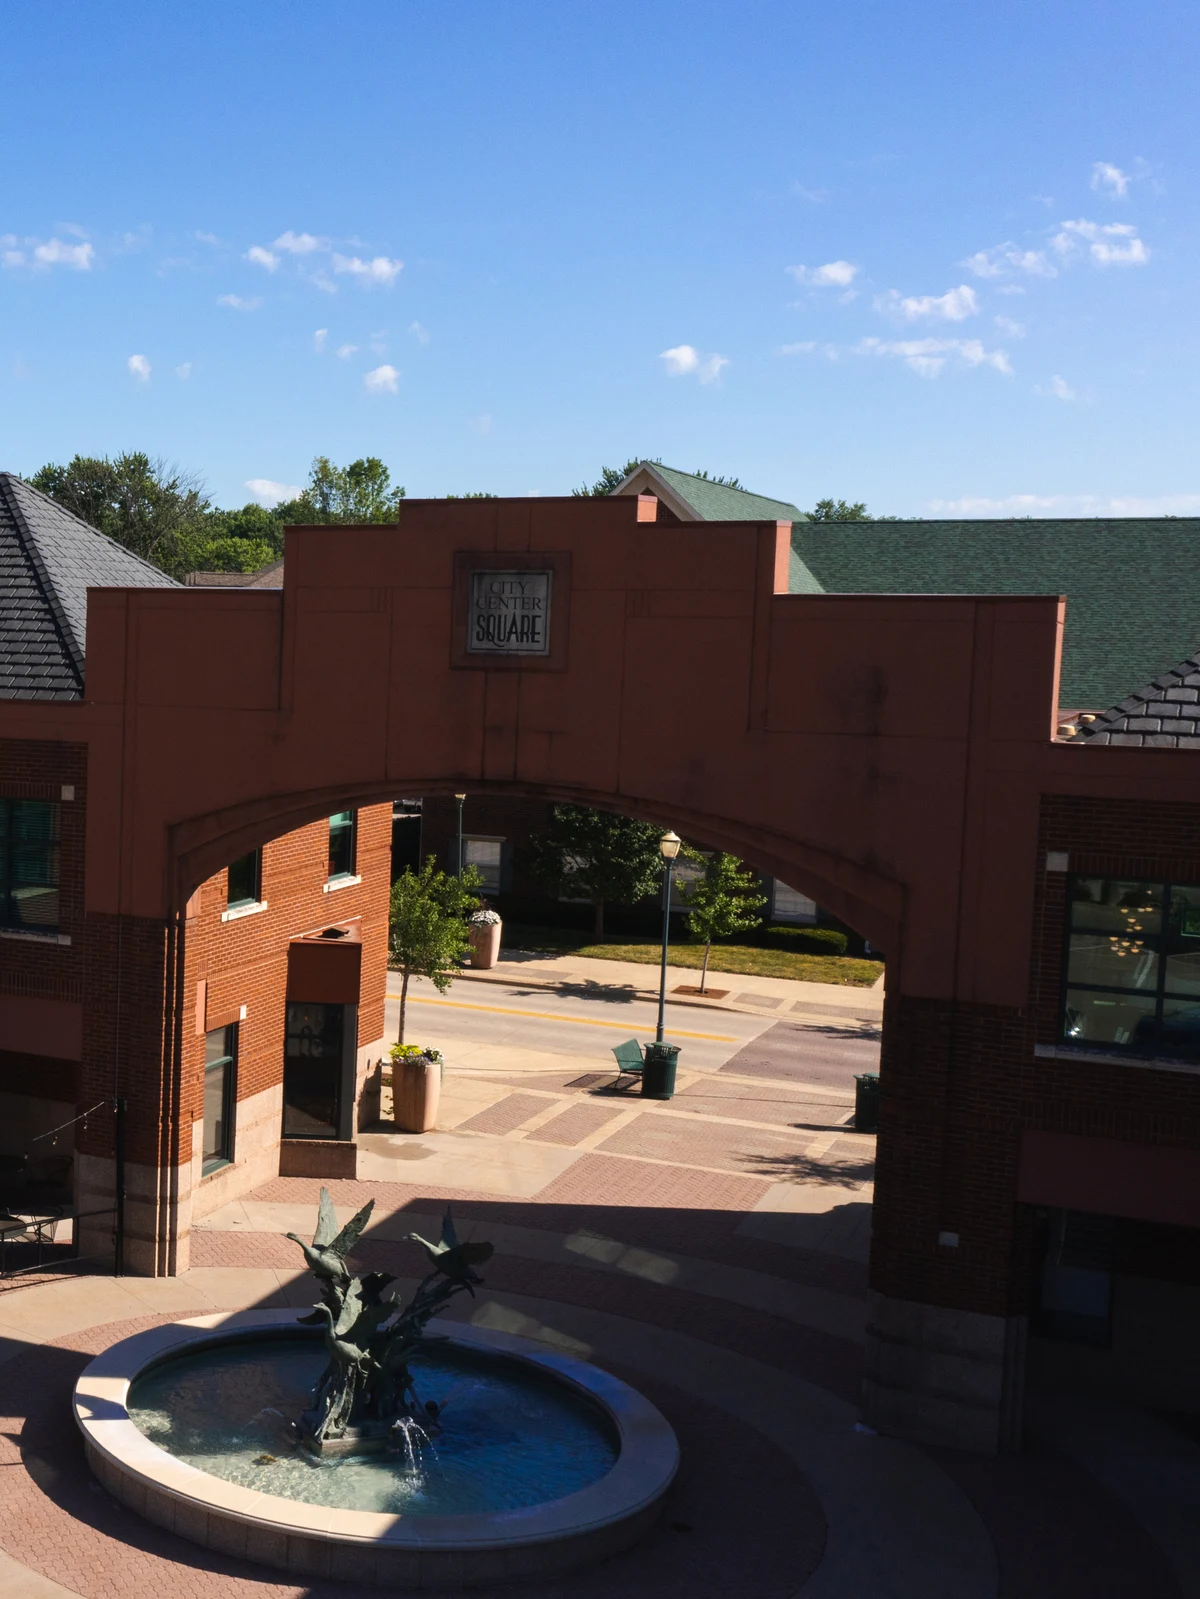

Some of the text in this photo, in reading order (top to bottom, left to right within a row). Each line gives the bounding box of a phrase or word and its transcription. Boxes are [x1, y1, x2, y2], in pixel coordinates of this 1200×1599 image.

[490, 581, 531, 594] CITY
[477, 596, 542, 610] CENTER
[476, 611, 542, 647] SQUARE
